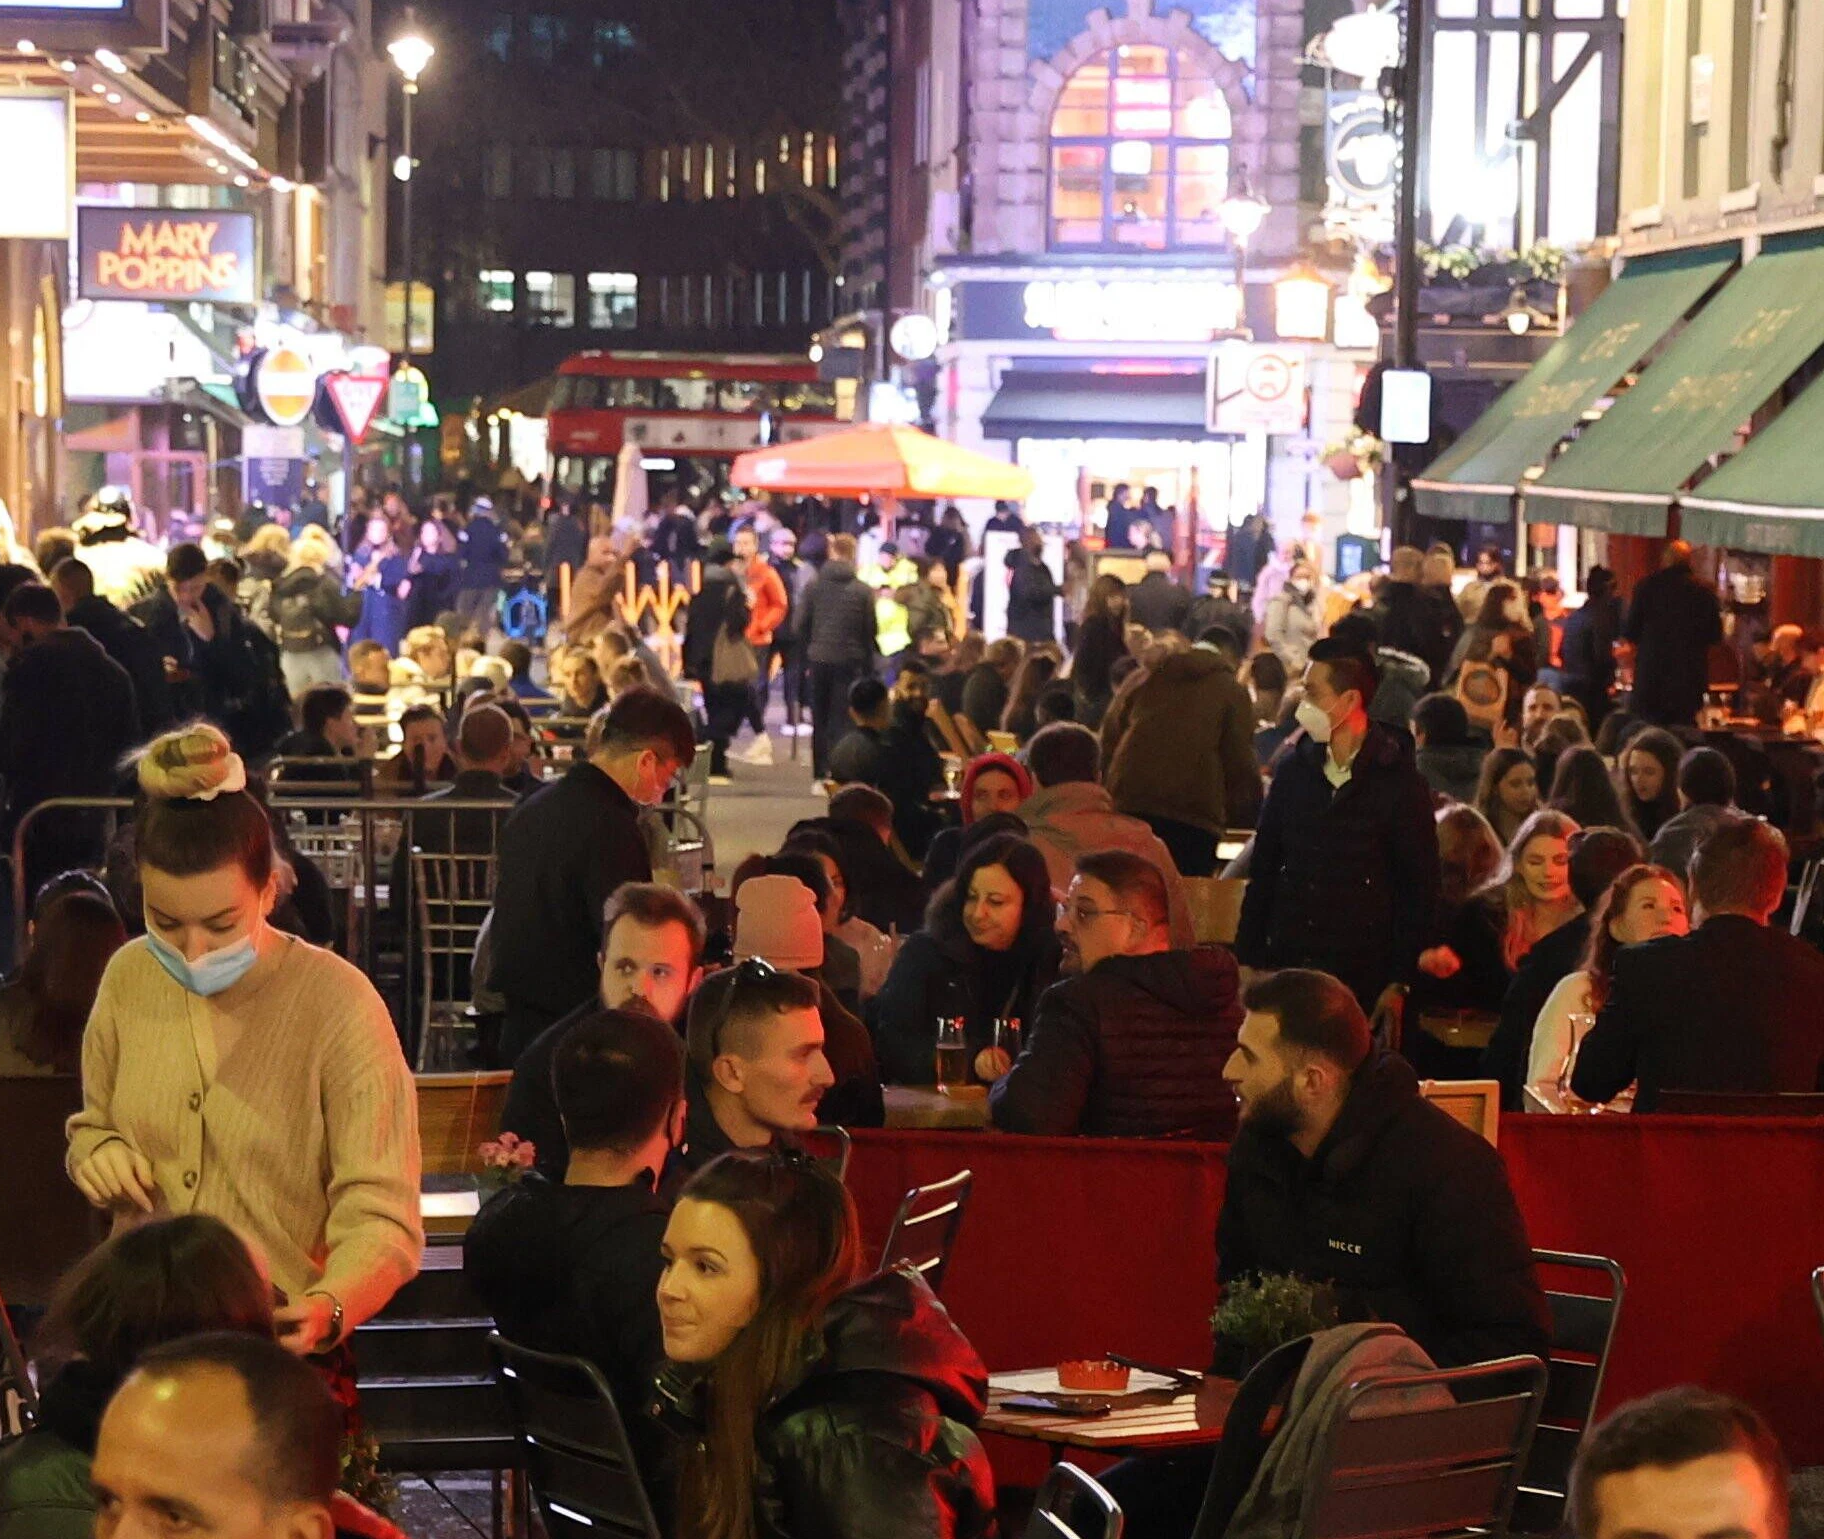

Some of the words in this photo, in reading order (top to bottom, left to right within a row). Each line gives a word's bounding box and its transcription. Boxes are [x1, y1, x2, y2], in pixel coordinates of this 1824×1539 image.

[121, 220, 218, 258] MARY
[97, 249, 239, 292] POPPINS
[1327, 1237, 1363, 1256] NICCE
